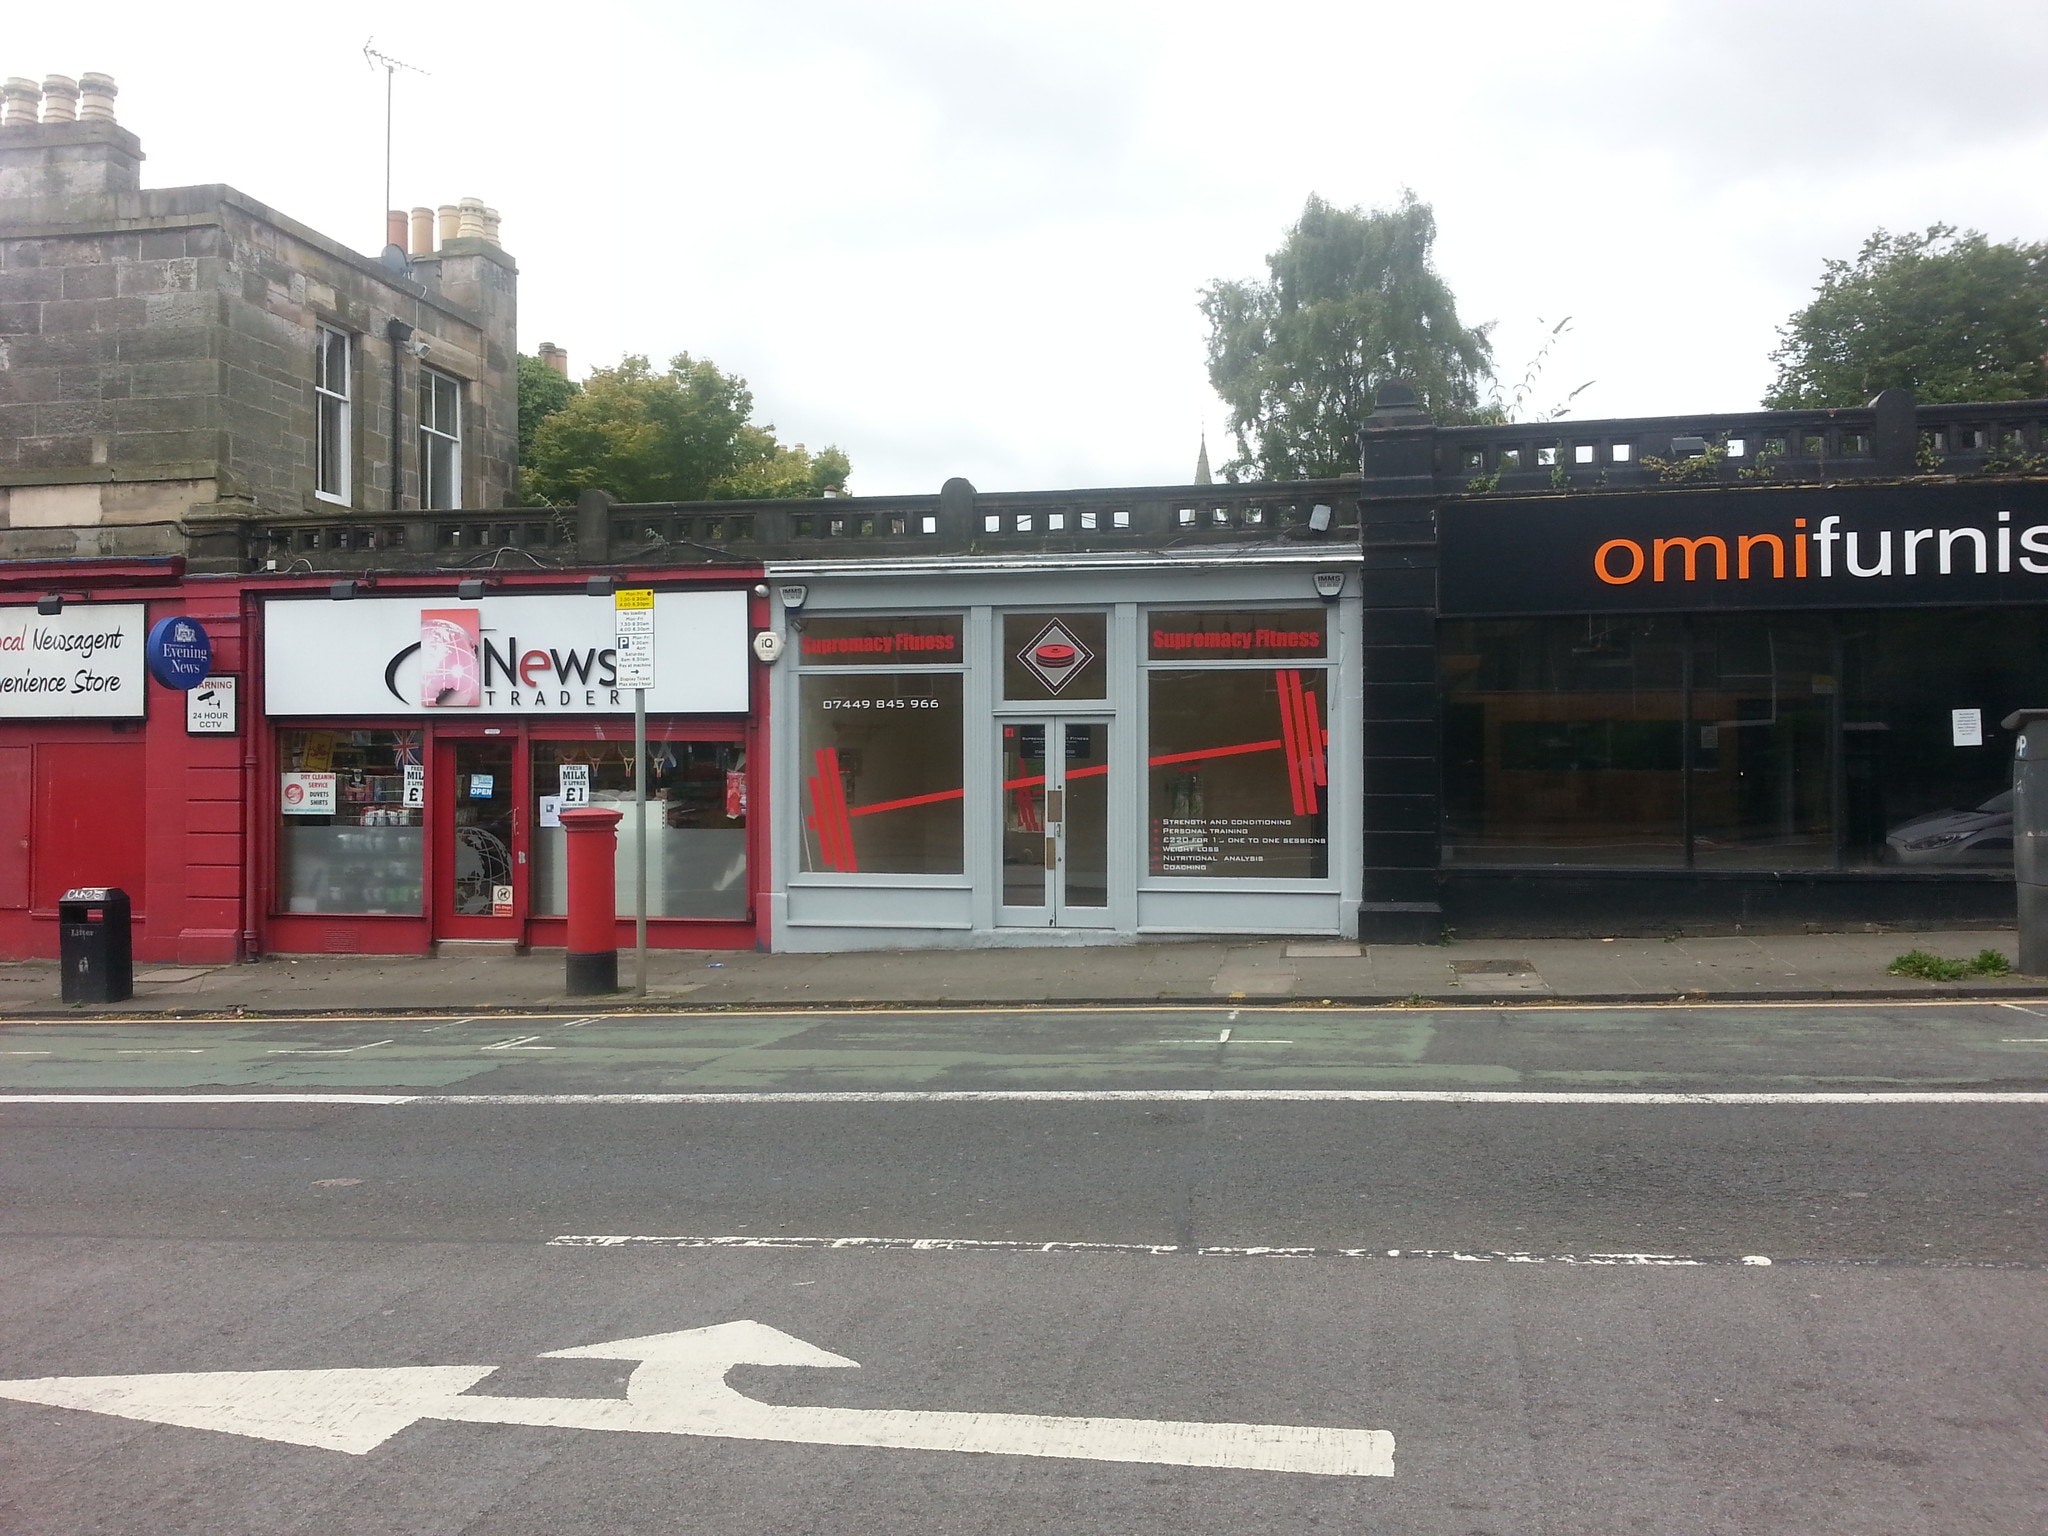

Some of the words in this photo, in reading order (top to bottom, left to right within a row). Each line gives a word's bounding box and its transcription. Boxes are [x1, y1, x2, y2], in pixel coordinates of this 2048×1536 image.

[0, 623, 27, 651] cal
[32, 625, 124, 659] Newsagent
[620, 638, 627, 649] P
[761, 638, 773, 649] iQ
[802, 636, 892, 655] Supremacy
[895, 633, 955, 651] Fitness
[1153, 630, 1252, 649] Supremacy
[1255, 629, 1319, 648] Fitness
[163, 643, 208, 662] Evening
[171, 659, 200, 674] News
[484, 636, 616, 687] News
[70, 667, 121, 694] Store
[194, 681, 232, 689] ARNING
[485, 690, 620, 706] TRADER
[823, 700, 871, 709] 07449
[876, 699, 905, 709] 845
[910, 699, 939, 709] 966
[407, 771, 424, 780] MIL
[563, 771, 586, 779] MILK
[471, 788, 491, 796] OPEN
[566, 788, 583, 801] £1
[70, 929, 95, 937] Litter
